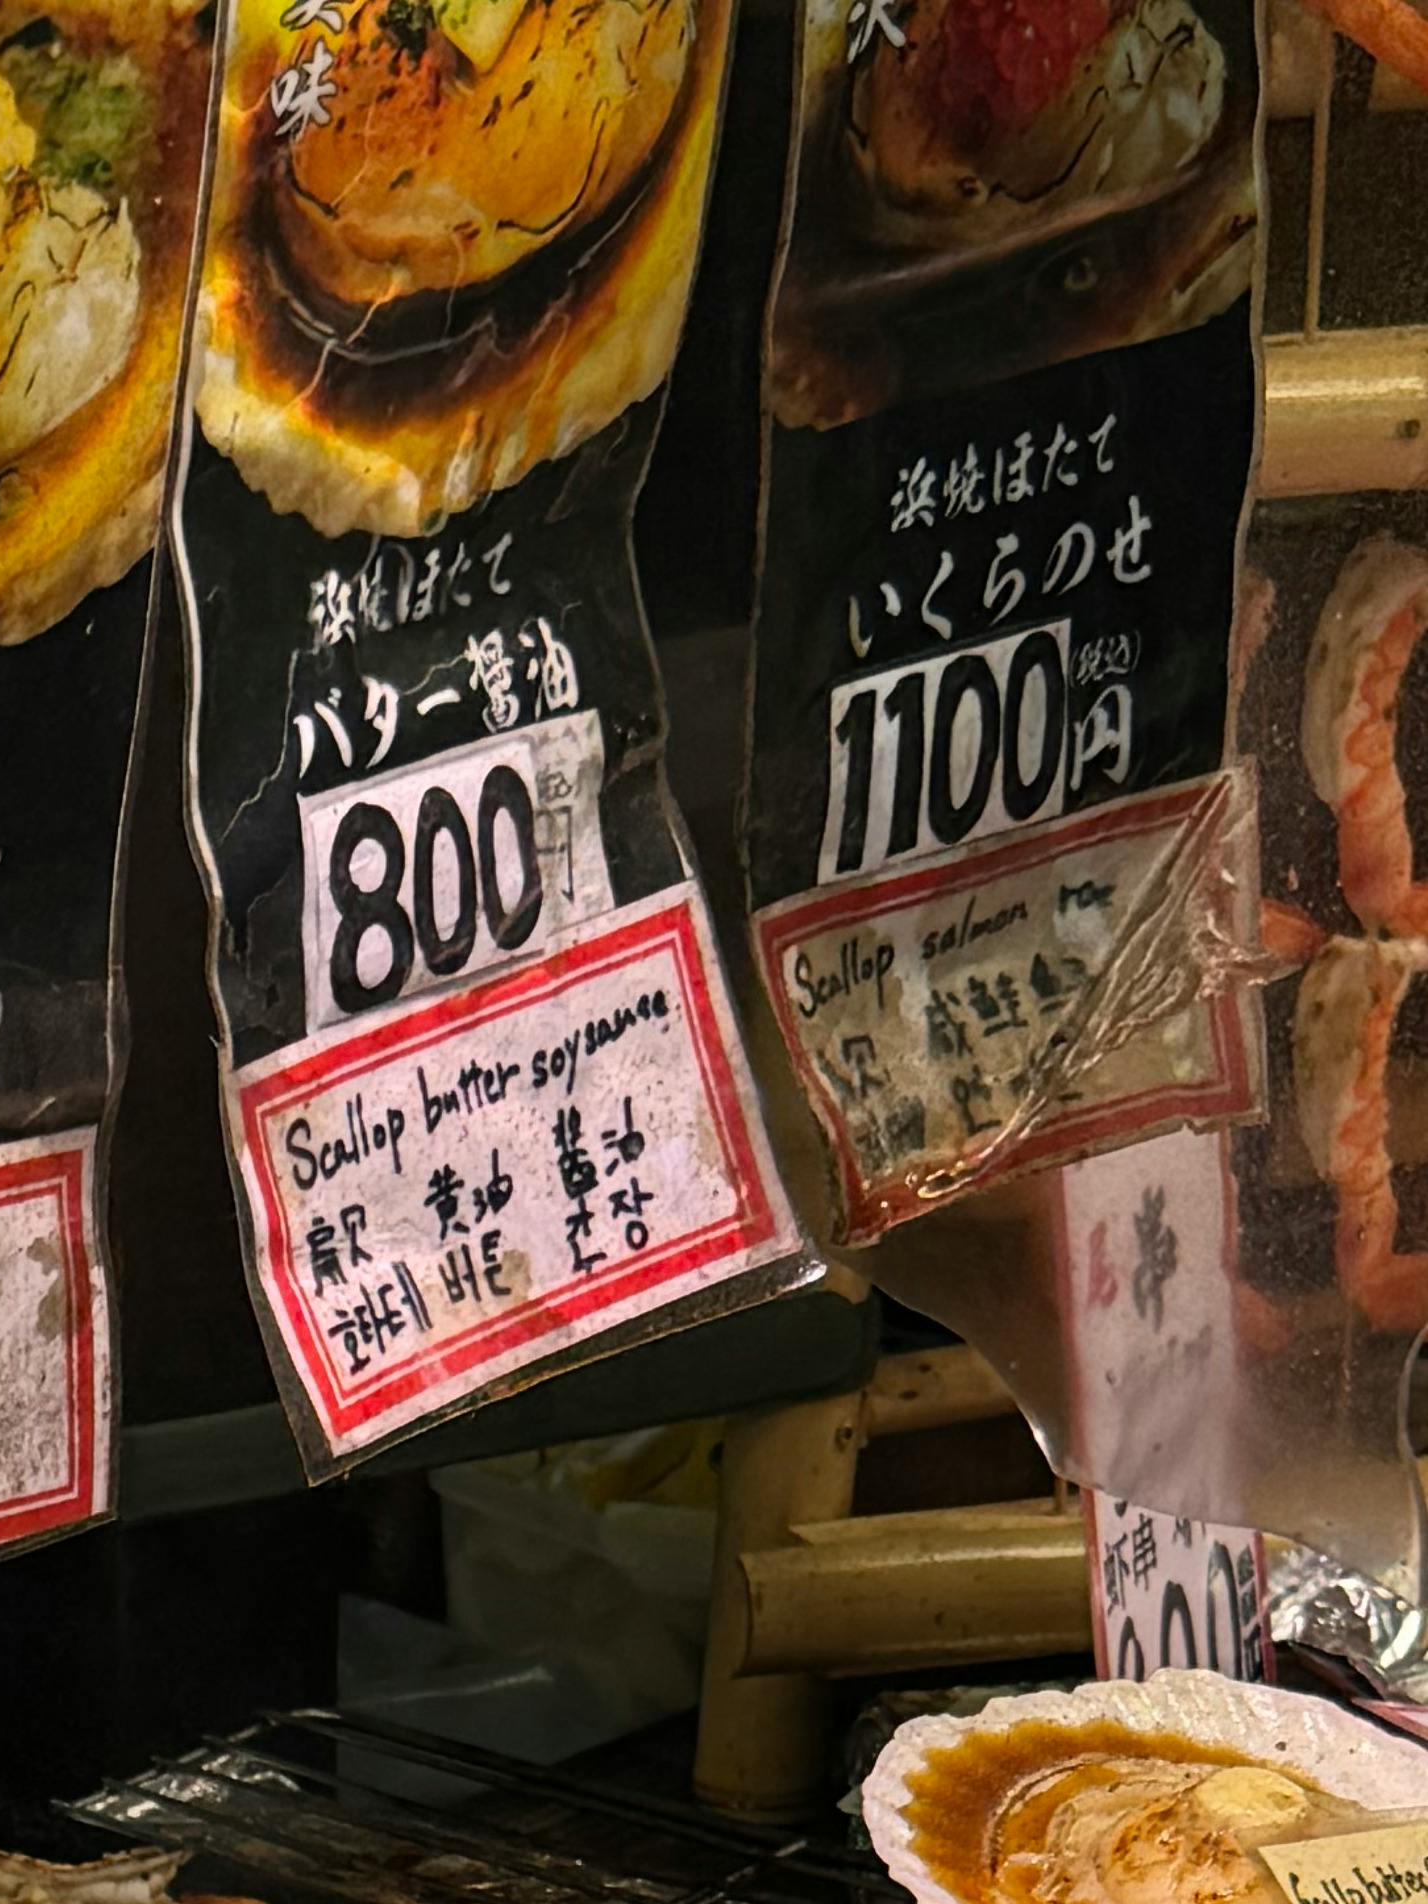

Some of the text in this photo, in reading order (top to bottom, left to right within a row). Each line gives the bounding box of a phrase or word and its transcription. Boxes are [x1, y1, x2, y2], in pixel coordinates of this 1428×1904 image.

[890, 413, 1117, 533] 浜焼ほたて
[849, 495, 1152, 658] いくらのせ
[835, 630, 1067, 874] 1100
[1069, 684, 1132, 791] 円
[329, 764, 543, 1013] 800
[795, 942, 895, 1018] Scallop
[922, 895, 1028, 960] salmon
[286, 1094, 405, 1190] Scallop
[418, 1059, 519, 1134] butter
